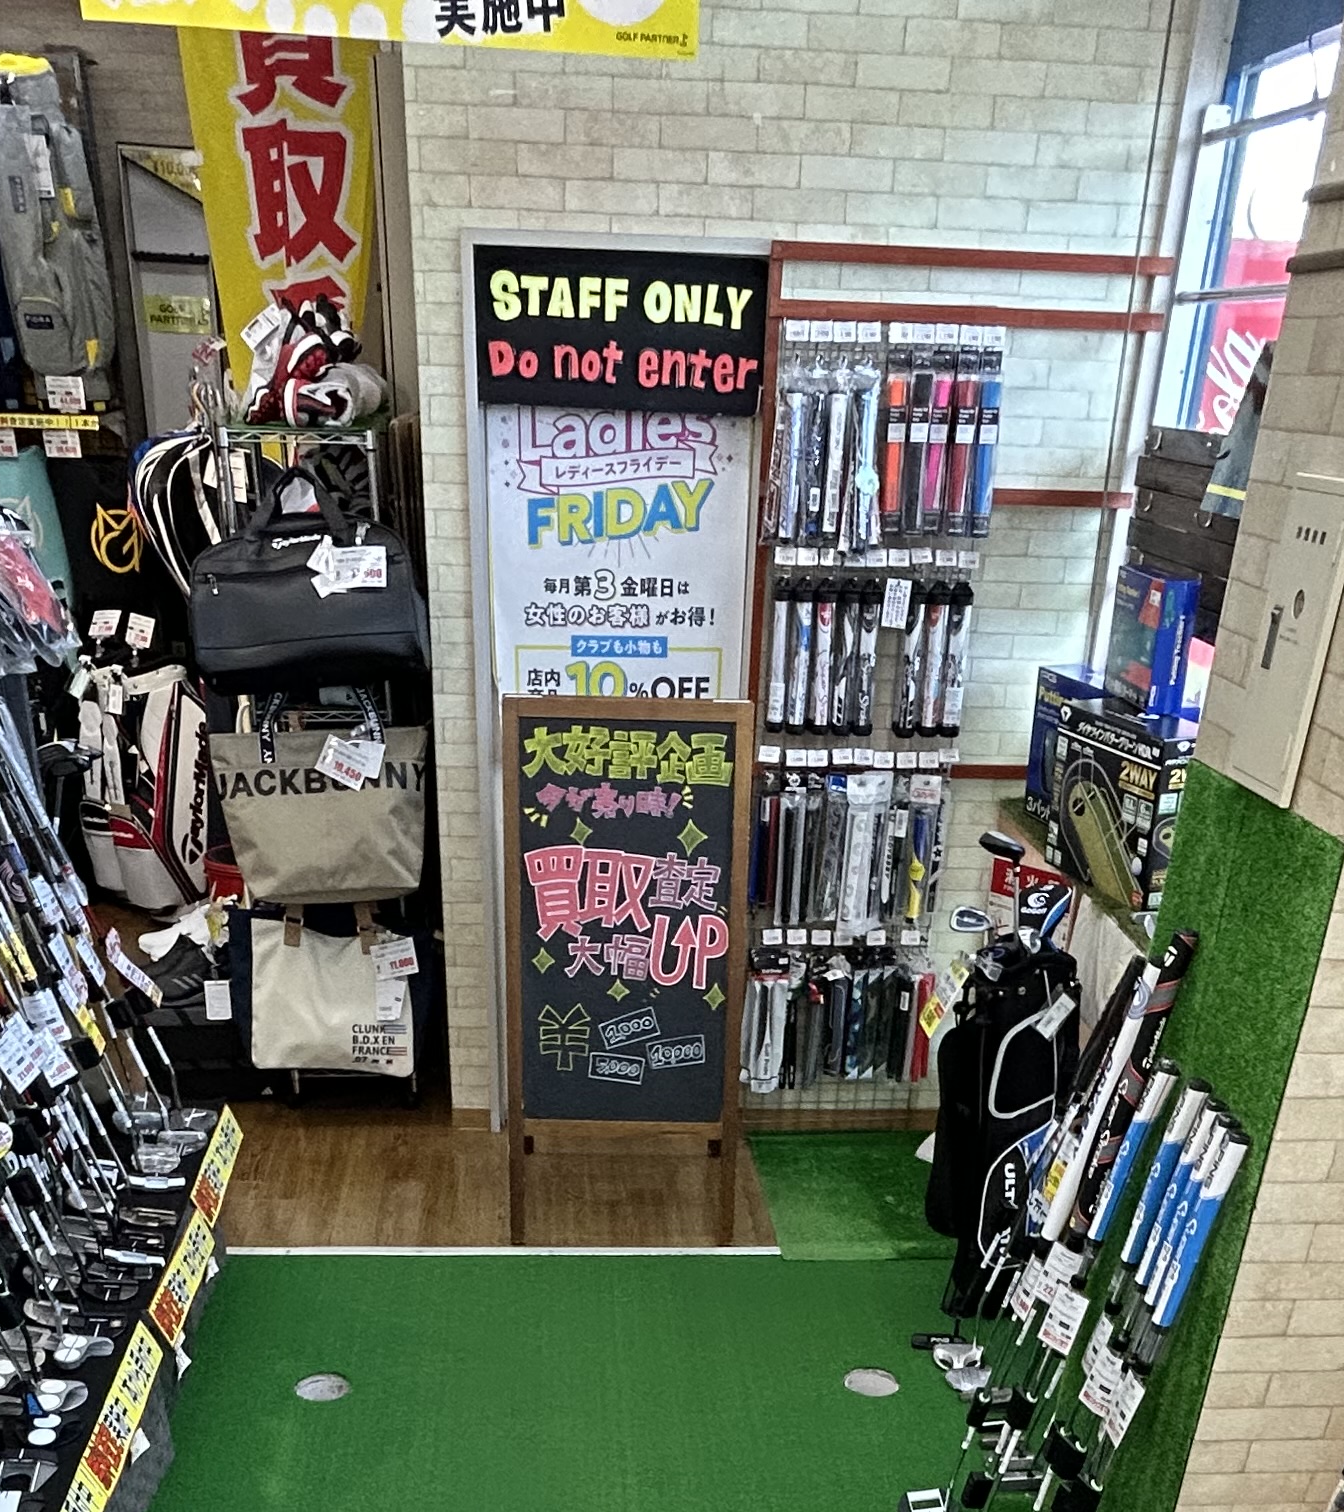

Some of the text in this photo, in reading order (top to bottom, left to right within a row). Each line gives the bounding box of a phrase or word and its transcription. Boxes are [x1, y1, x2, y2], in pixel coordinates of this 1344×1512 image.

[489, 269, 753, 330] STAFF ONLY
[489, 339, 758, 393] Do not enter
[555, 457, 681, 480] レディースフライデー
[527, 478, 716, 549] FRIDAY
[543, 569, 689, 600] 毎月第3金曜日は
[527, 669, 560, 687] 店内
[522, 724, 733, 787] 大好評企画
[1119, 761, 1157, 790] 2WAY
